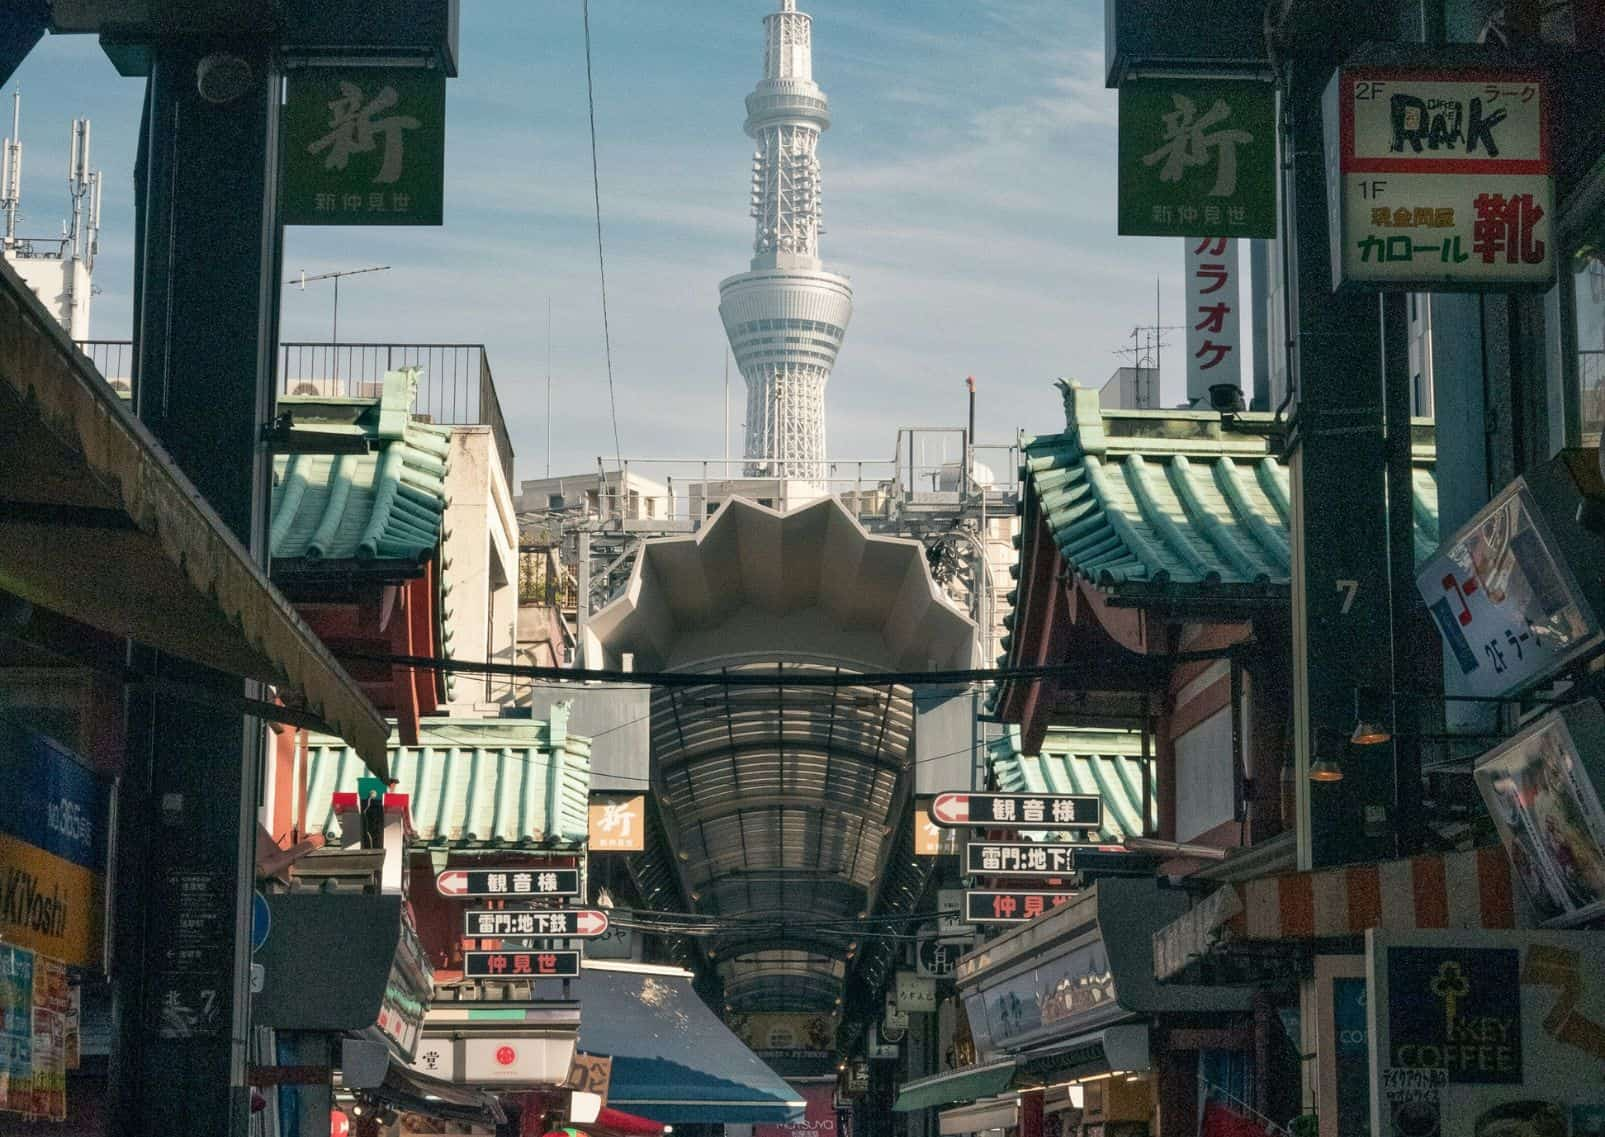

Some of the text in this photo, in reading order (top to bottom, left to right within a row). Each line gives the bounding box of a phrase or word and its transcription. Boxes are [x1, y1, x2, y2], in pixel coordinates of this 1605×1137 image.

[1356, 82, 1386, 101] 2F
[1484, 85, 1536, 104] ラーク
[306, 81, 422, 184] 新
[1142, 93, 1253, 198] 新
[1358, 181, 1388, 200] 1F
[1152, 205, 1249, 227] 新仲見世
[1473, 192, 1546, 265] 靴
[1358, 235, 1469, 263] カロール
[1336, 579, 1360, 614] 7
[597, 799, 636, 837] 新
[992, 798, 1075, 823] 観音様
[982, 846, 1072, 871] 雷門:地下
[487, 872, 558, 893] 観音様
[487, 954, 557, 974] 仲見世
[200, 989, 217, 1014] 7
[1396, 1044, 1514, 1072] COFFEE
